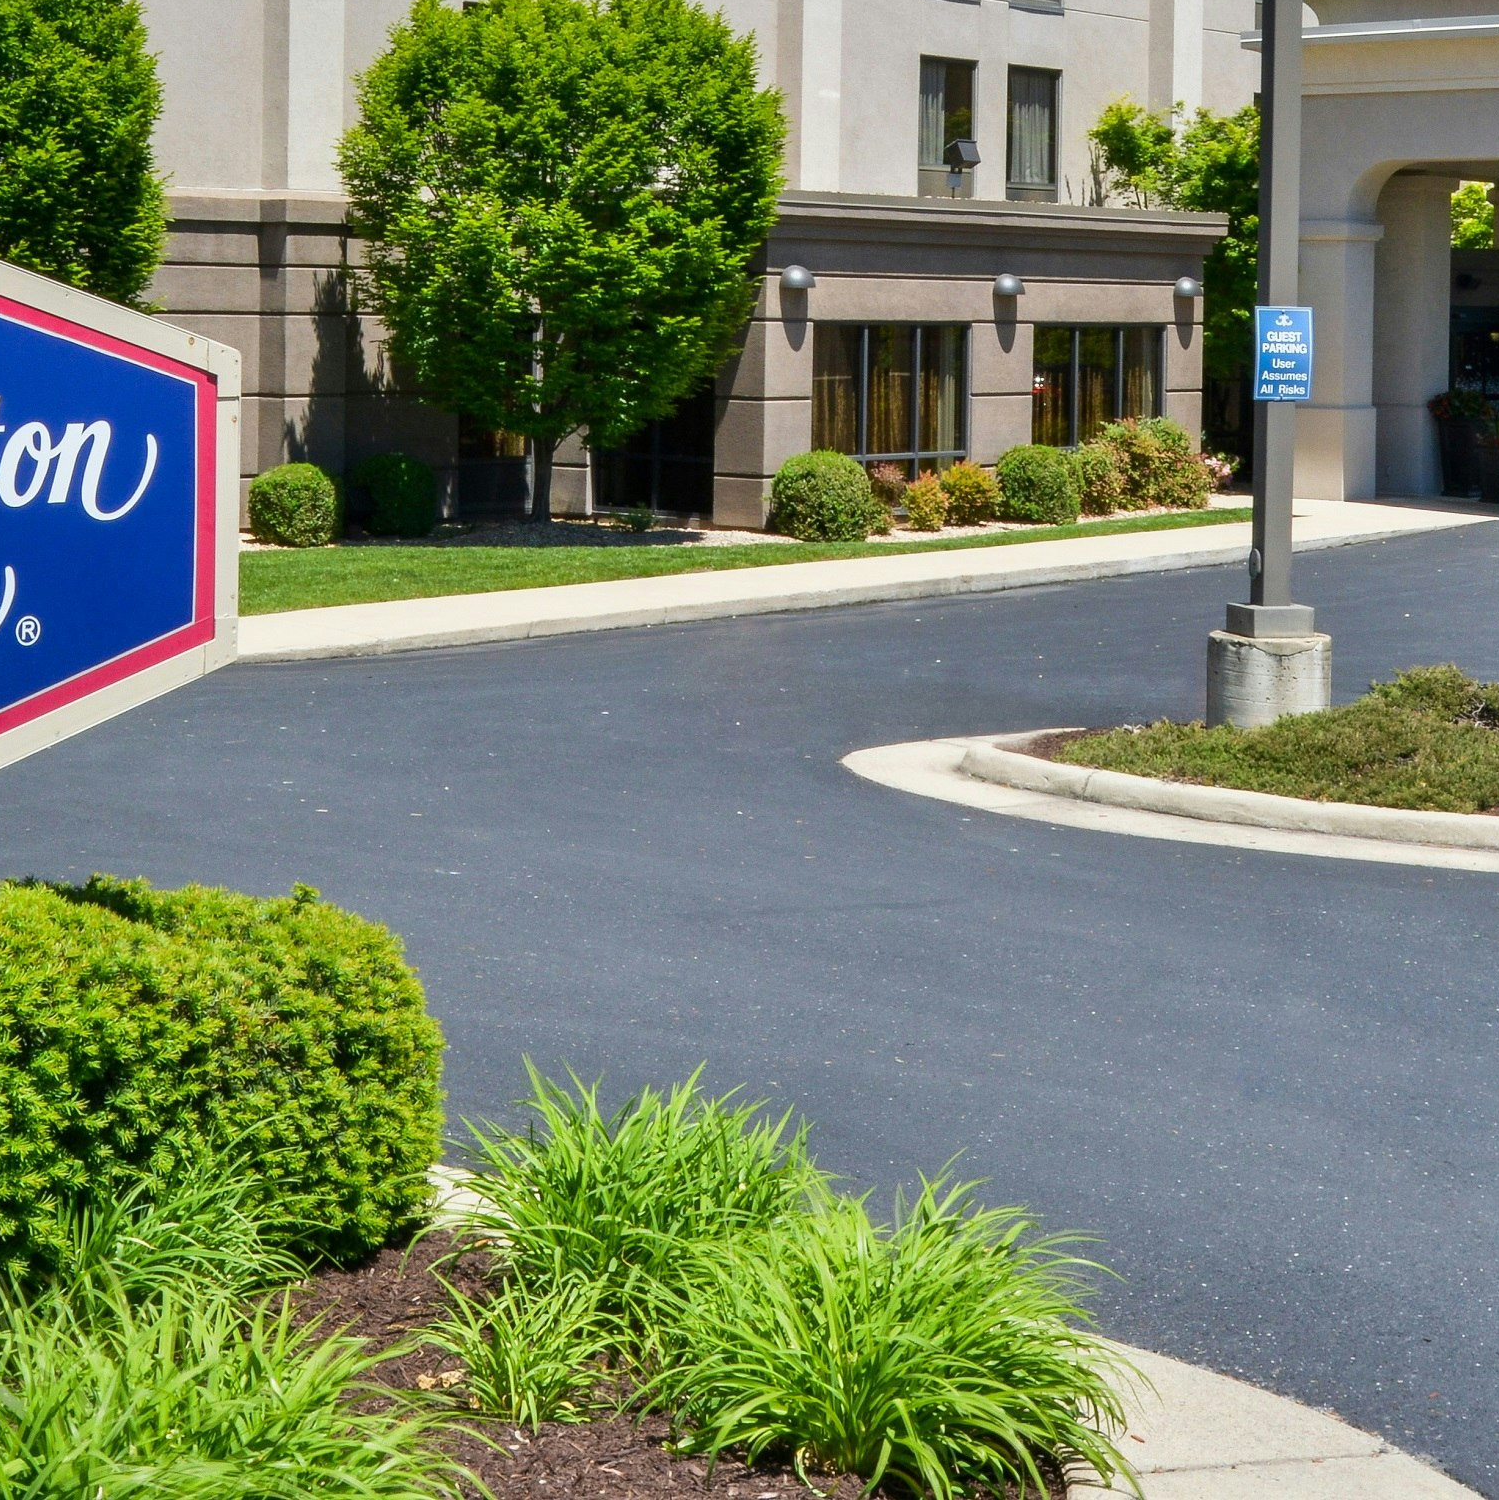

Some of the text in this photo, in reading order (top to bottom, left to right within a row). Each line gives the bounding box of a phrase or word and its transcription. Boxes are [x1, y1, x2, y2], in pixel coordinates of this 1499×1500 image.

[1266, 331, 1303, 343] GUEST
[1262, 343, 1308, 354] PARKING
[1272, 358, 1296, 369] User
[1262, 370, 1308, 381] Assumes
[1260, 384, 1306, 395] All Risks
